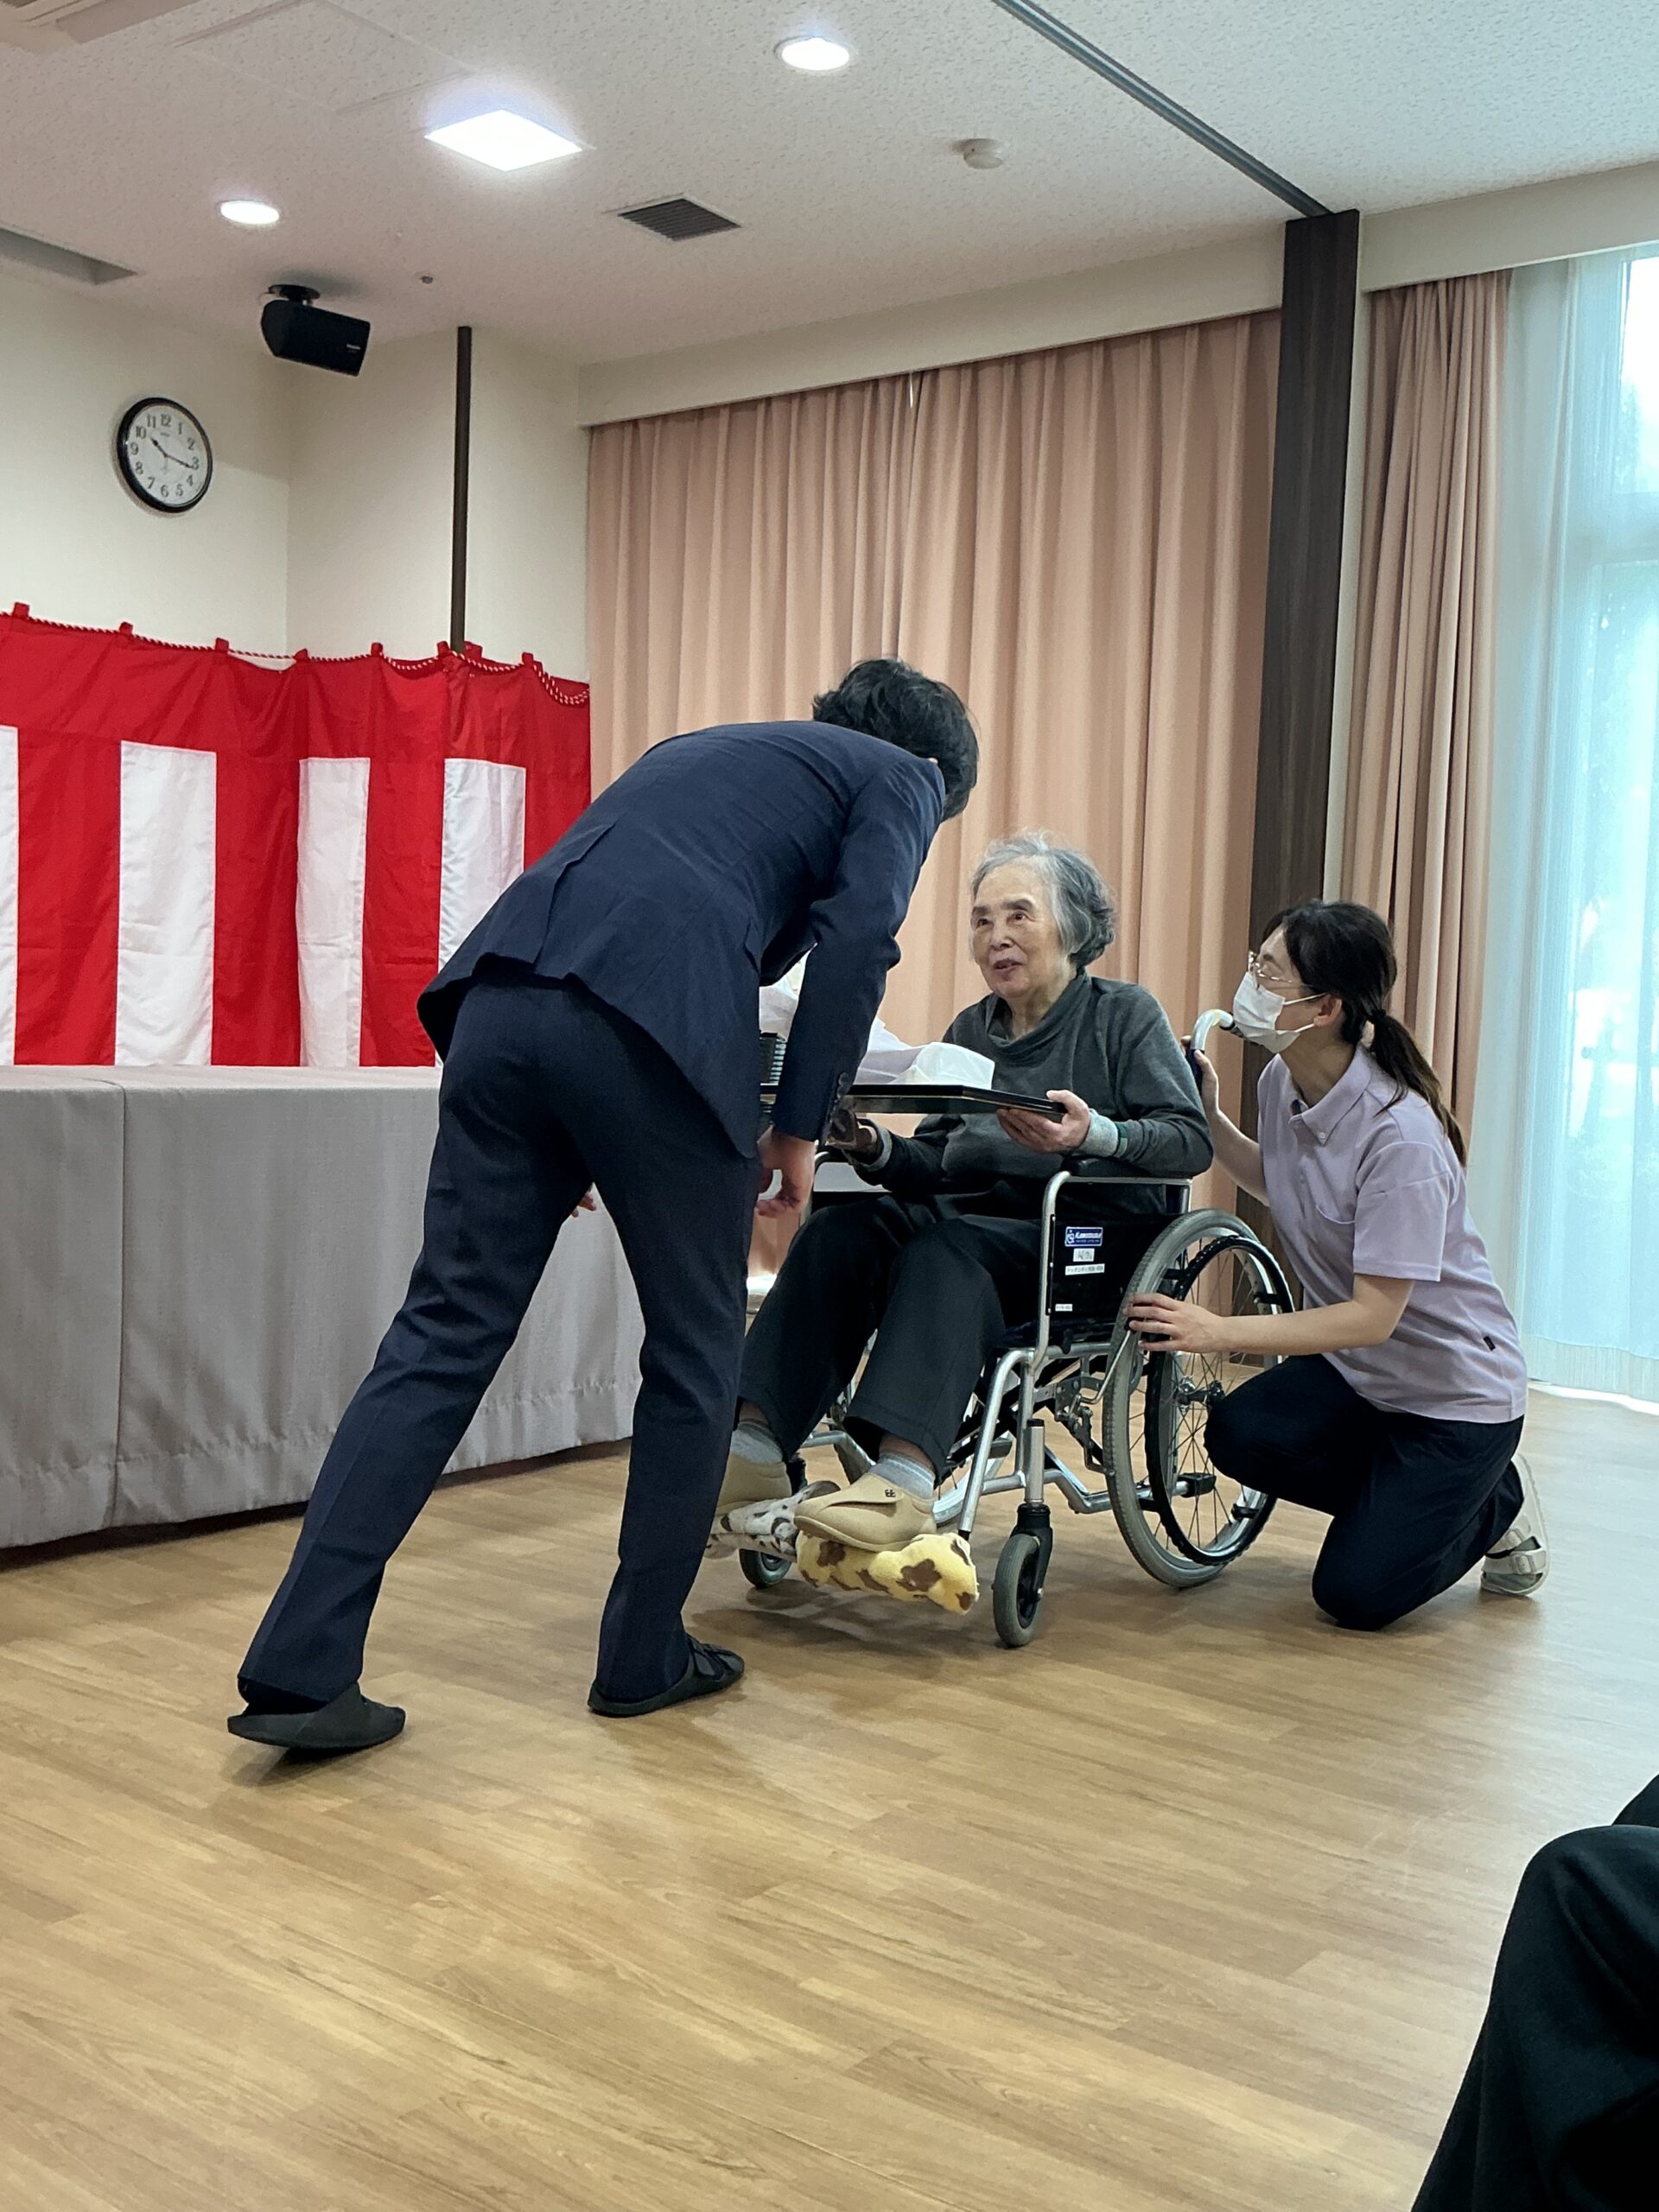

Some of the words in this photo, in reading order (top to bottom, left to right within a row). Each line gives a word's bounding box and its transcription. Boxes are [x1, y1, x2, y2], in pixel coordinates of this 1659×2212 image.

[147, 415, 156, 429] 11
[161, 414, 172, 428] 12
[136, 426, 147, 439] 10
[178, 422, 183, 435] 1
[130, 442, 139, 455] 9
[188, 437, 195, 451] 2
[135, 461, 143, 475] 8
[191, 456, 200, 471] 3
[147, 477, 156, 489] 7
[187, 474, 194, 486] 4
[161, 484, 169, 498] 6
[175, 484, 184, 497] 5
